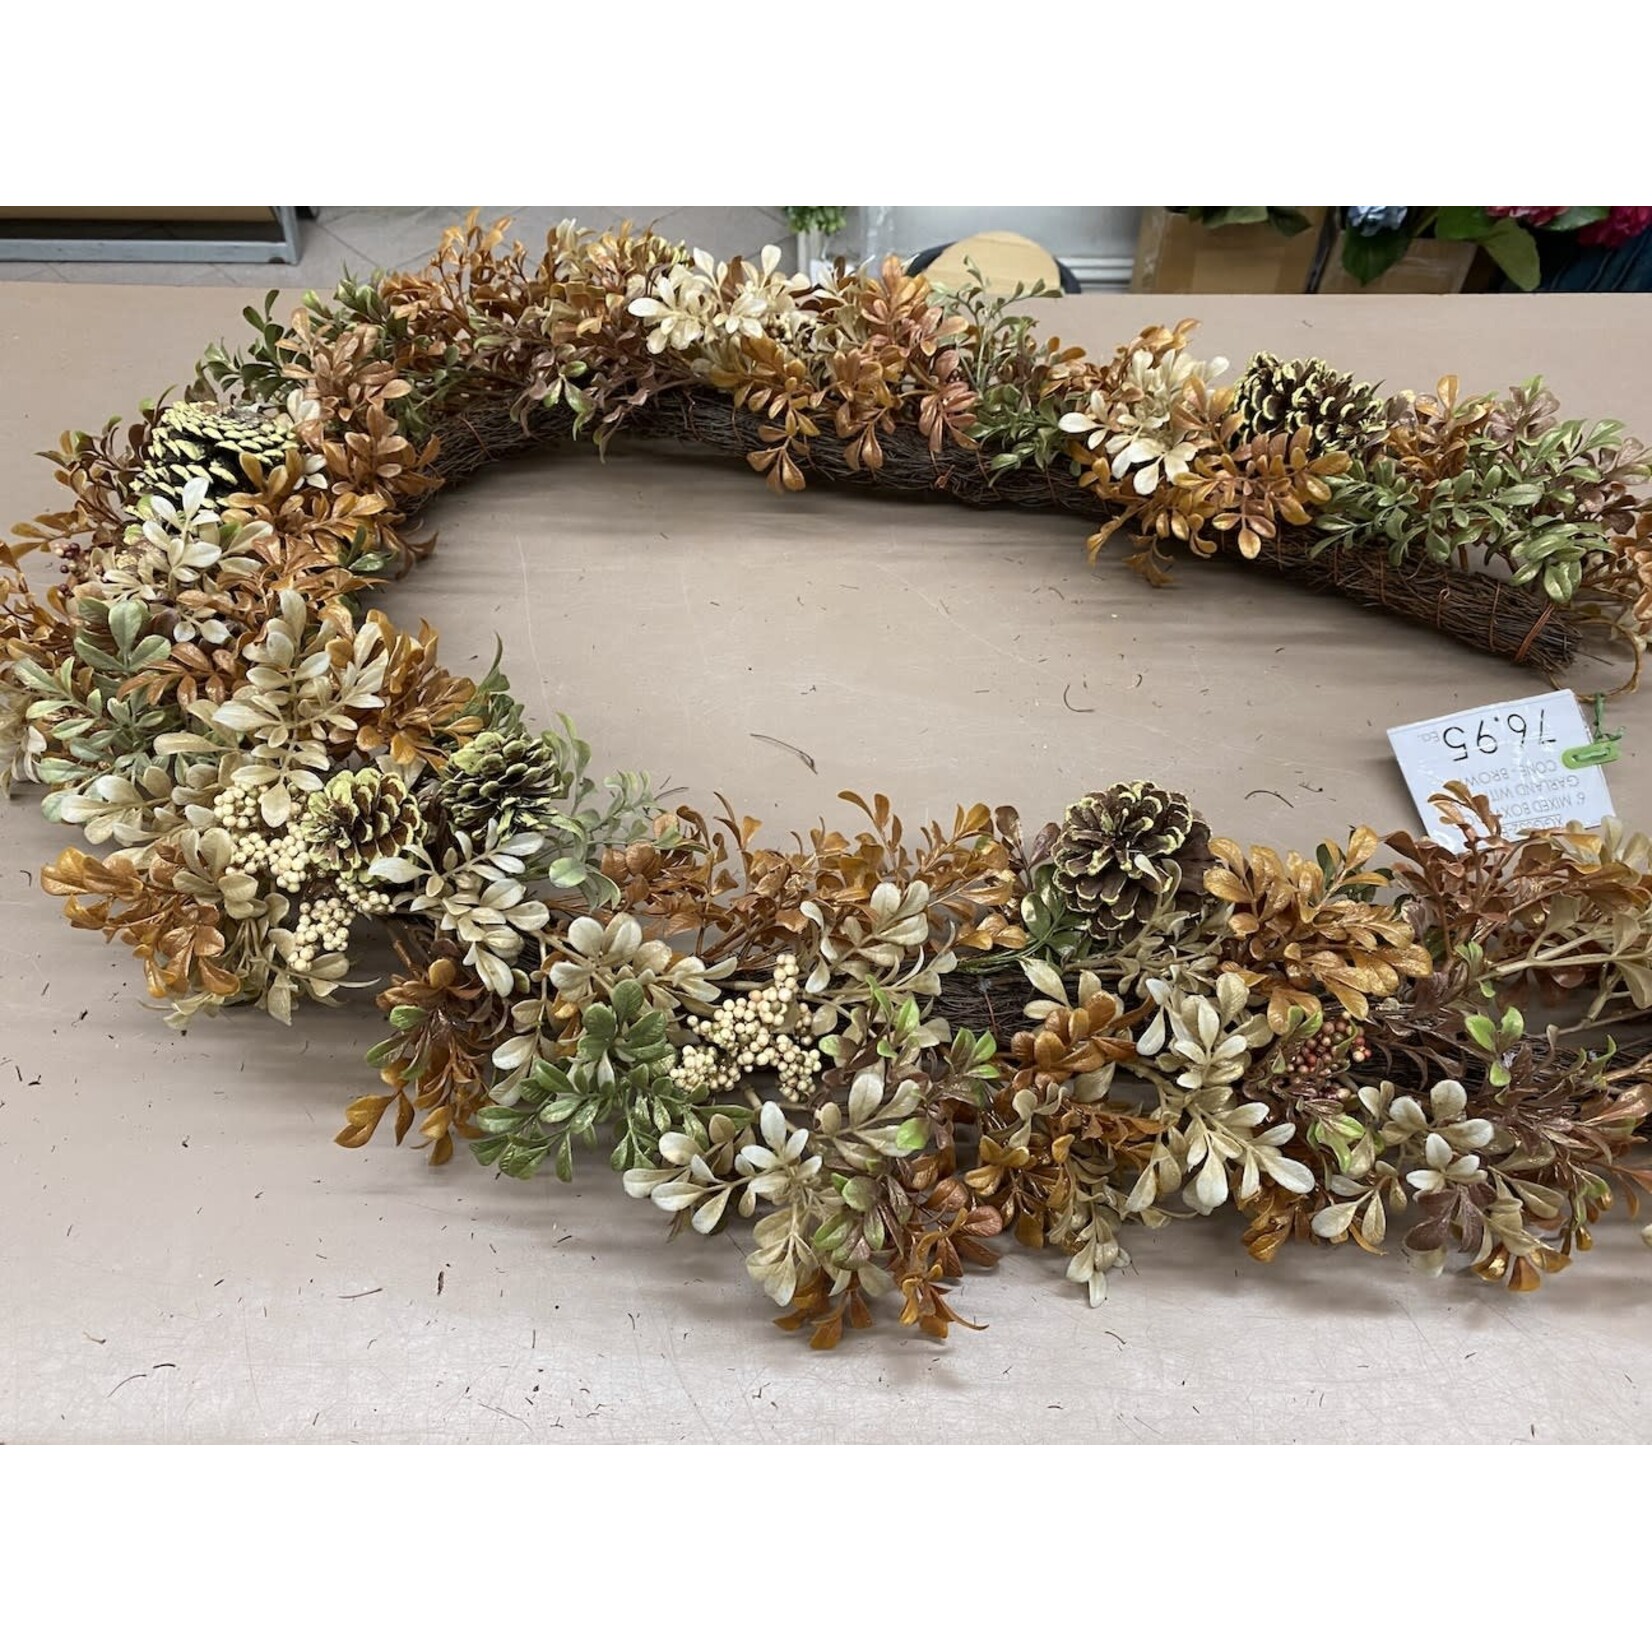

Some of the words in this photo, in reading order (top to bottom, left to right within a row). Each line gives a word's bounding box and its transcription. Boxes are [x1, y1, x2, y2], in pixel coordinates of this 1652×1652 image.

[1443, 709, 1557, 761] 76.95
[1519, 759, 1558, 775] CONE
[1515, 774, 1580, 796] GARLAND
[1532, 795, 1571, 812] MIXED
